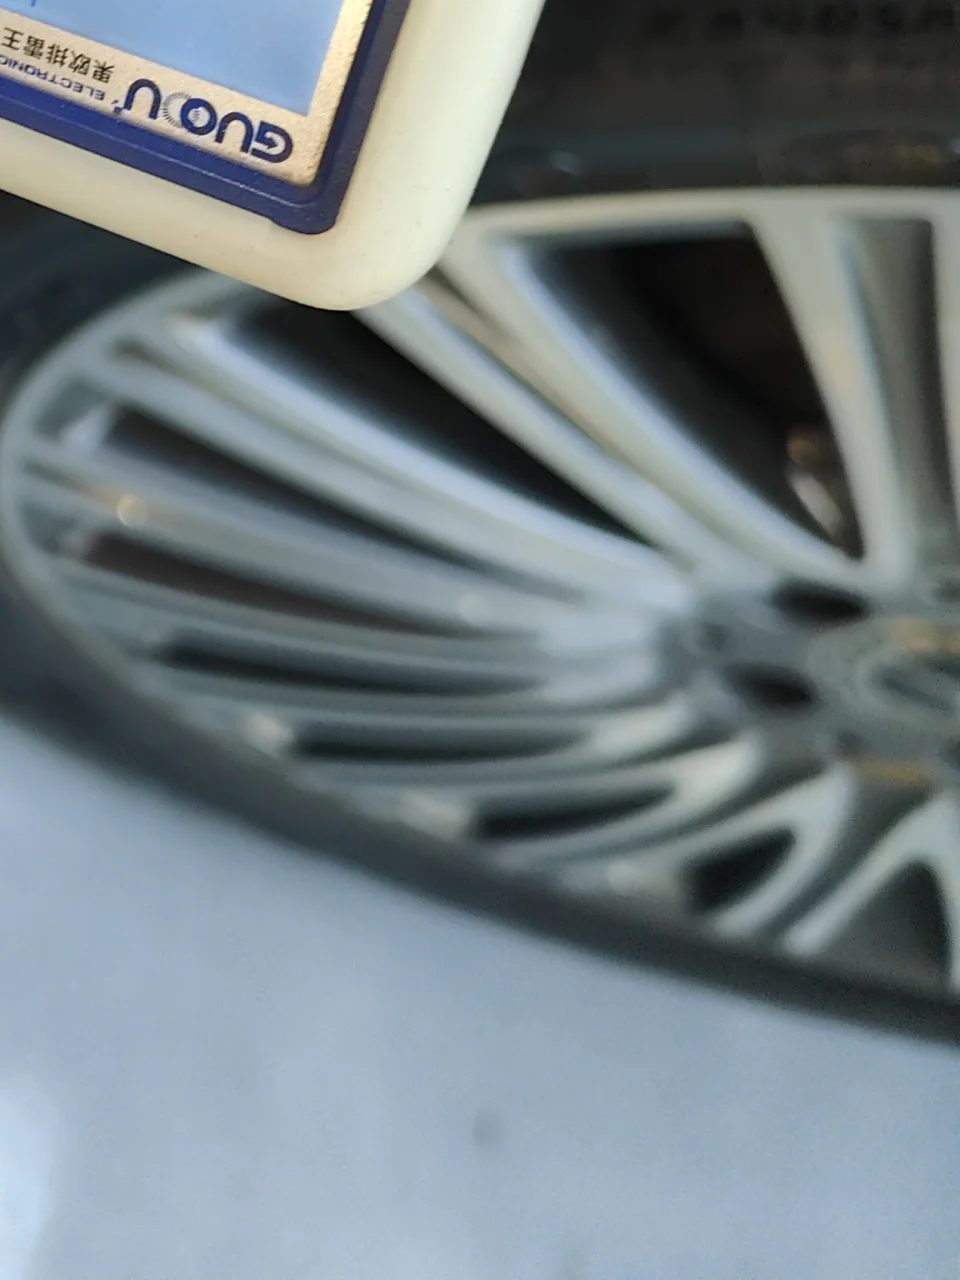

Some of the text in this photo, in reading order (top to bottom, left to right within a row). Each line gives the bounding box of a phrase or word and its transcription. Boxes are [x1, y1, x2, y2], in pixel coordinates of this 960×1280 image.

[2, 26, 116, 84] 果欧排雷王
